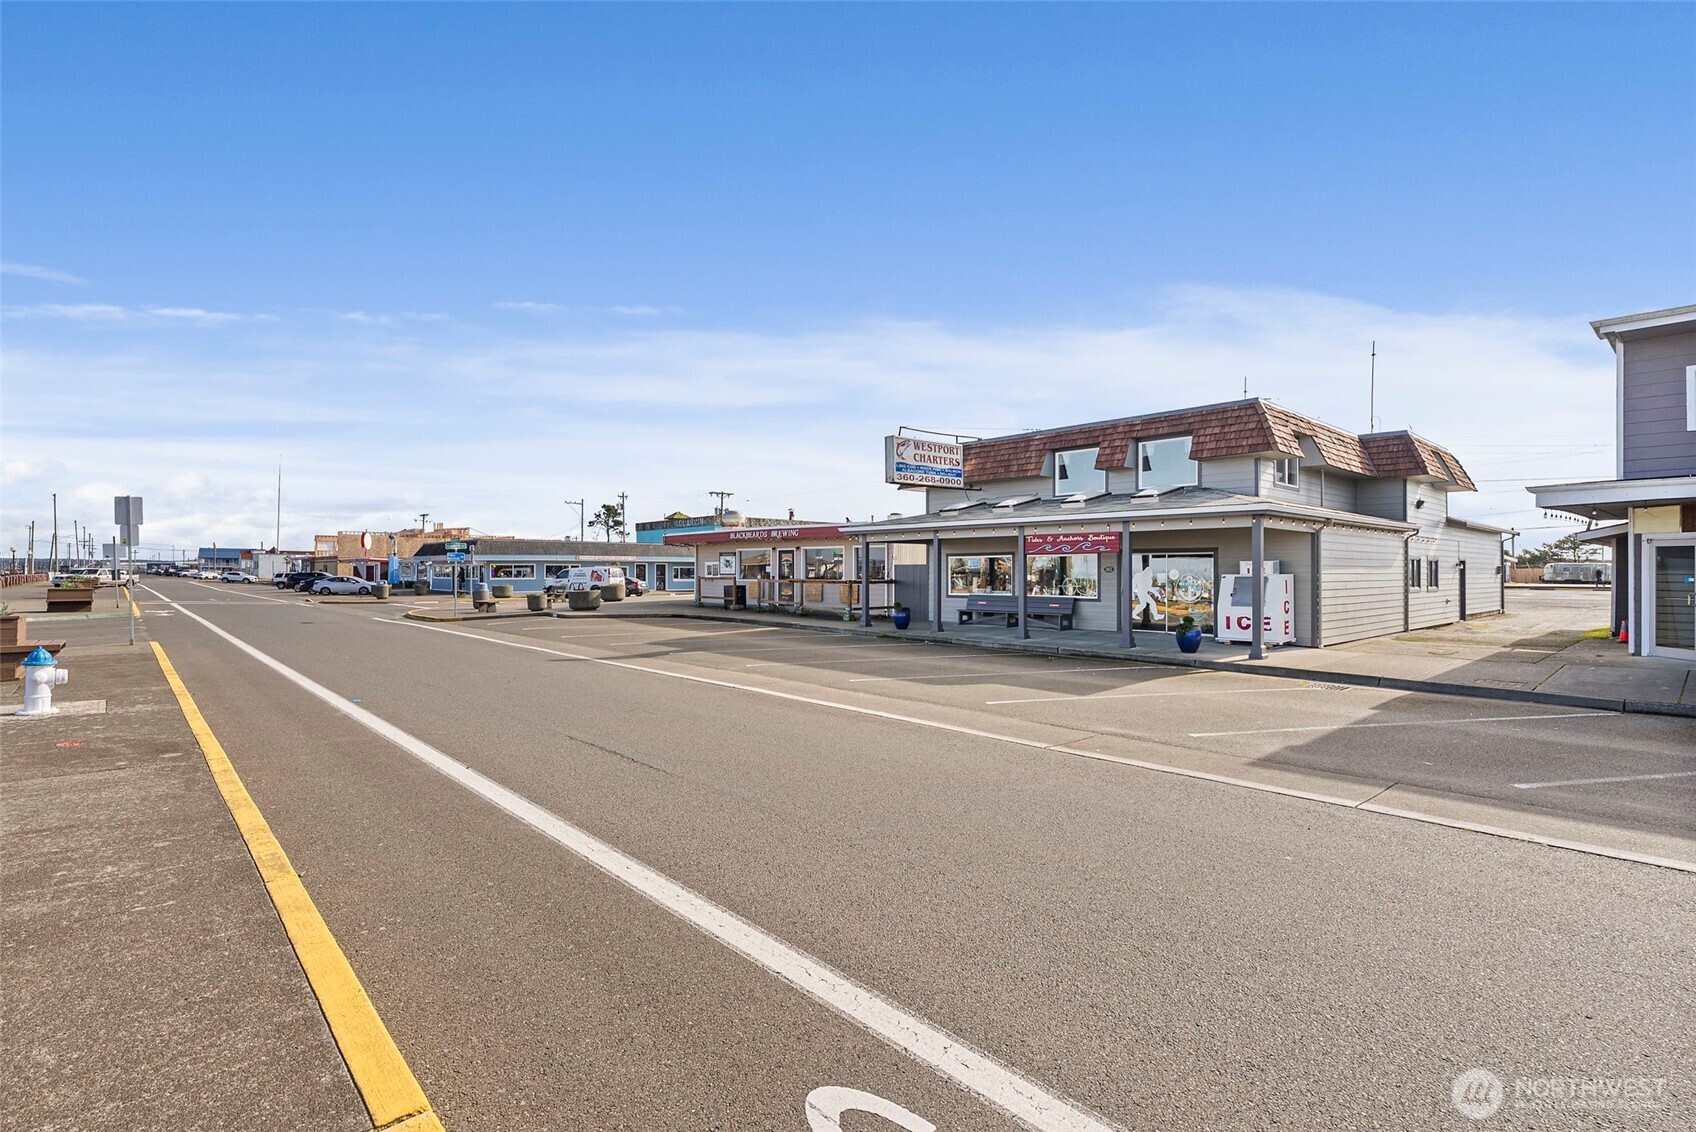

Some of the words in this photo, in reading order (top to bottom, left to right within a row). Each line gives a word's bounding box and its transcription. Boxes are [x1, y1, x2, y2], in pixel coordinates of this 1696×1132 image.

[913, 441, 959, 456] WESTPORT
[913, 453, 961, 467] CHARTERS
[897, 473, 962, 486] 360-268-0900
[730, 531, 767, 540] BLACKBEARDS
[771, 529, 798, 539] BREWING
[1047, 535, 1053, 543] &
[1057, 535, 1084, 543] Anchors
[1088, 533, 1116, 543] Boutique
